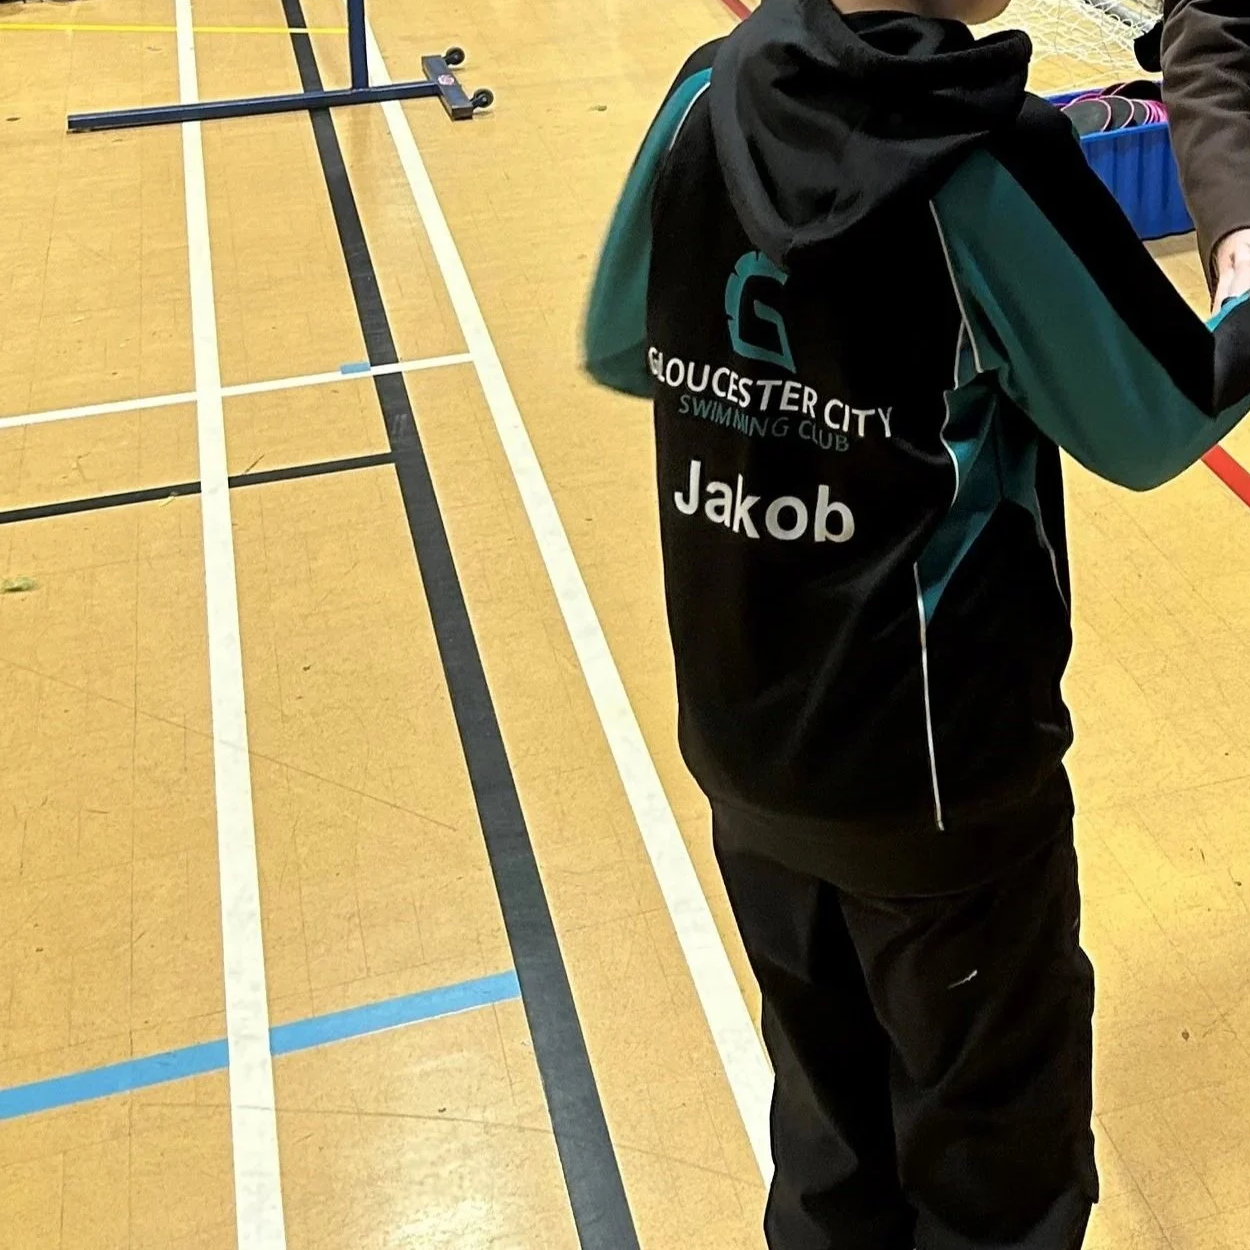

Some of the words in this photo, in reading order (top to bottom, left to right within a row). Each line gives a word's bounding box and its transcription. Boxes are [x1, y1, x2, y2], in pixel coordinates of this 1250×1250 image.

[648, 346, 818, 419] GLOUCESTER
[824, 398, 893, 438] CITY
[798, 419, 850, 452] CLUB
[674, 459, 855, 543] Jakob
